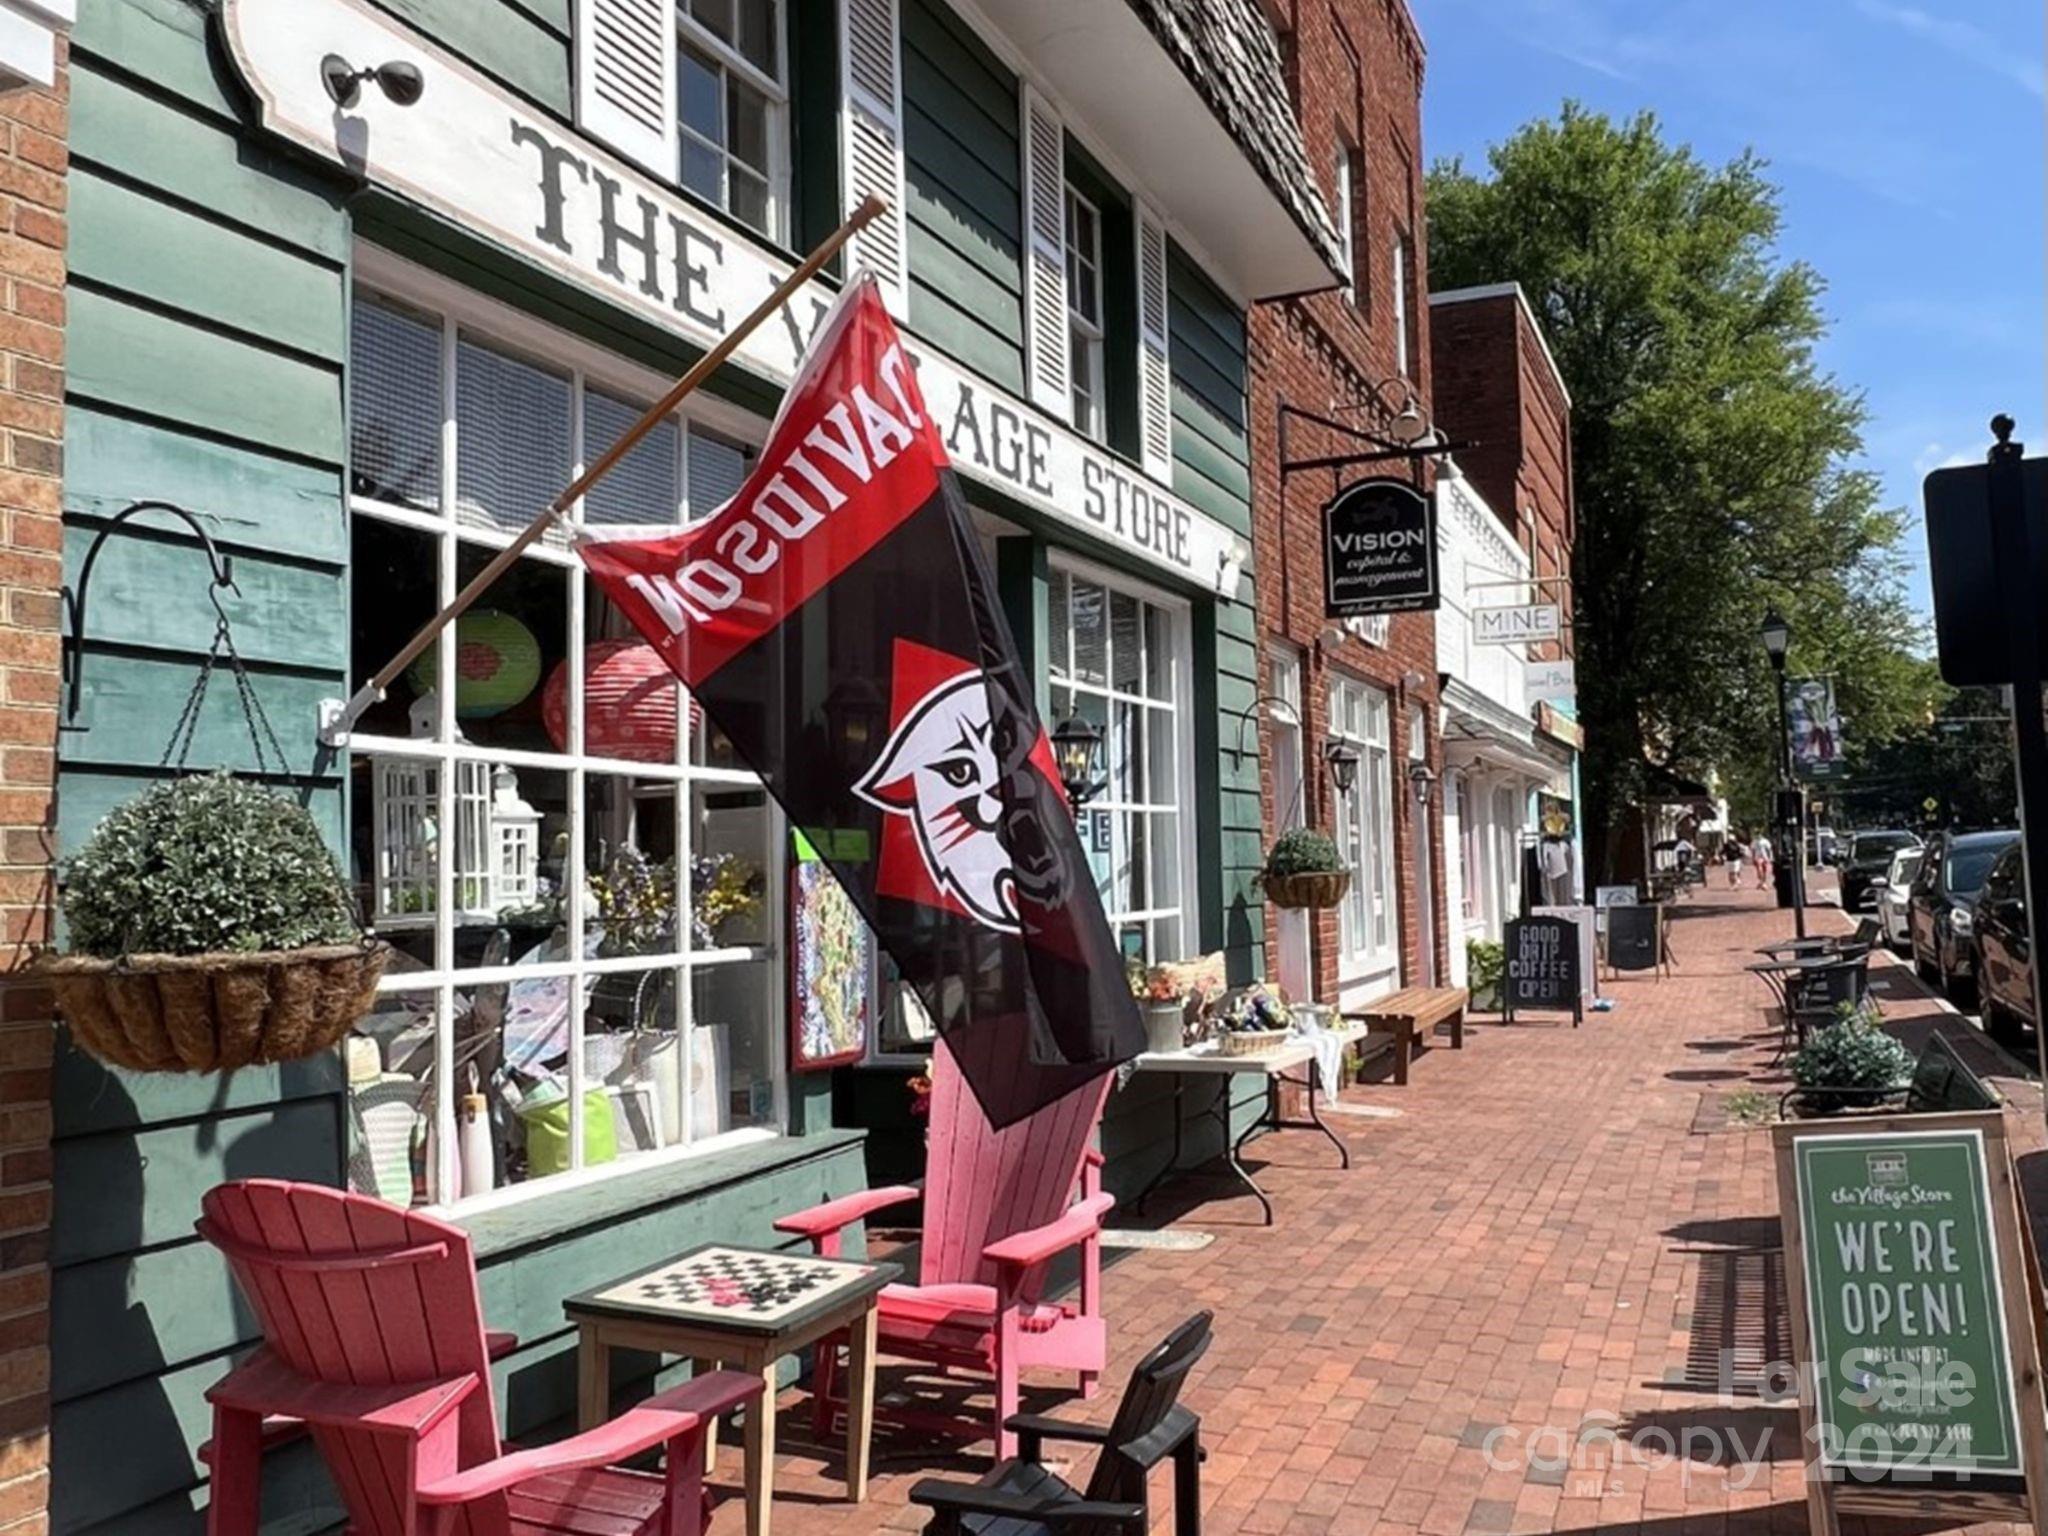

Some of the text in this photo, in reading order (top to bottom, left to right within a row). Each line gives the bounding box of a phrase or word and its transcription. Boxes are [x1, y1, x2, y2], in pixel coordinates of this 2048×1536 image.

[511, 118, 1192, 568] THE VAGE STORE
[1333, 527, 1425, 553] VISION
[1346, 550, 1397, 573] capital
[1334, 567, 1425, 588] management
[1482, 607, 1550, 632] MINE
[1519, 925, 1559, 943] GOOD
[1509, 960, 1570, 979] COFFEE
[1519, 980, 1559, 998] OPEN
[1853, 1185, 1910, 1210] Village
[1910, 1184, 1953, 1204] Store
[1834, 1218, 1961, 1273] WE'RE
[1841, 1282, 1969, 1337] OPEN!
